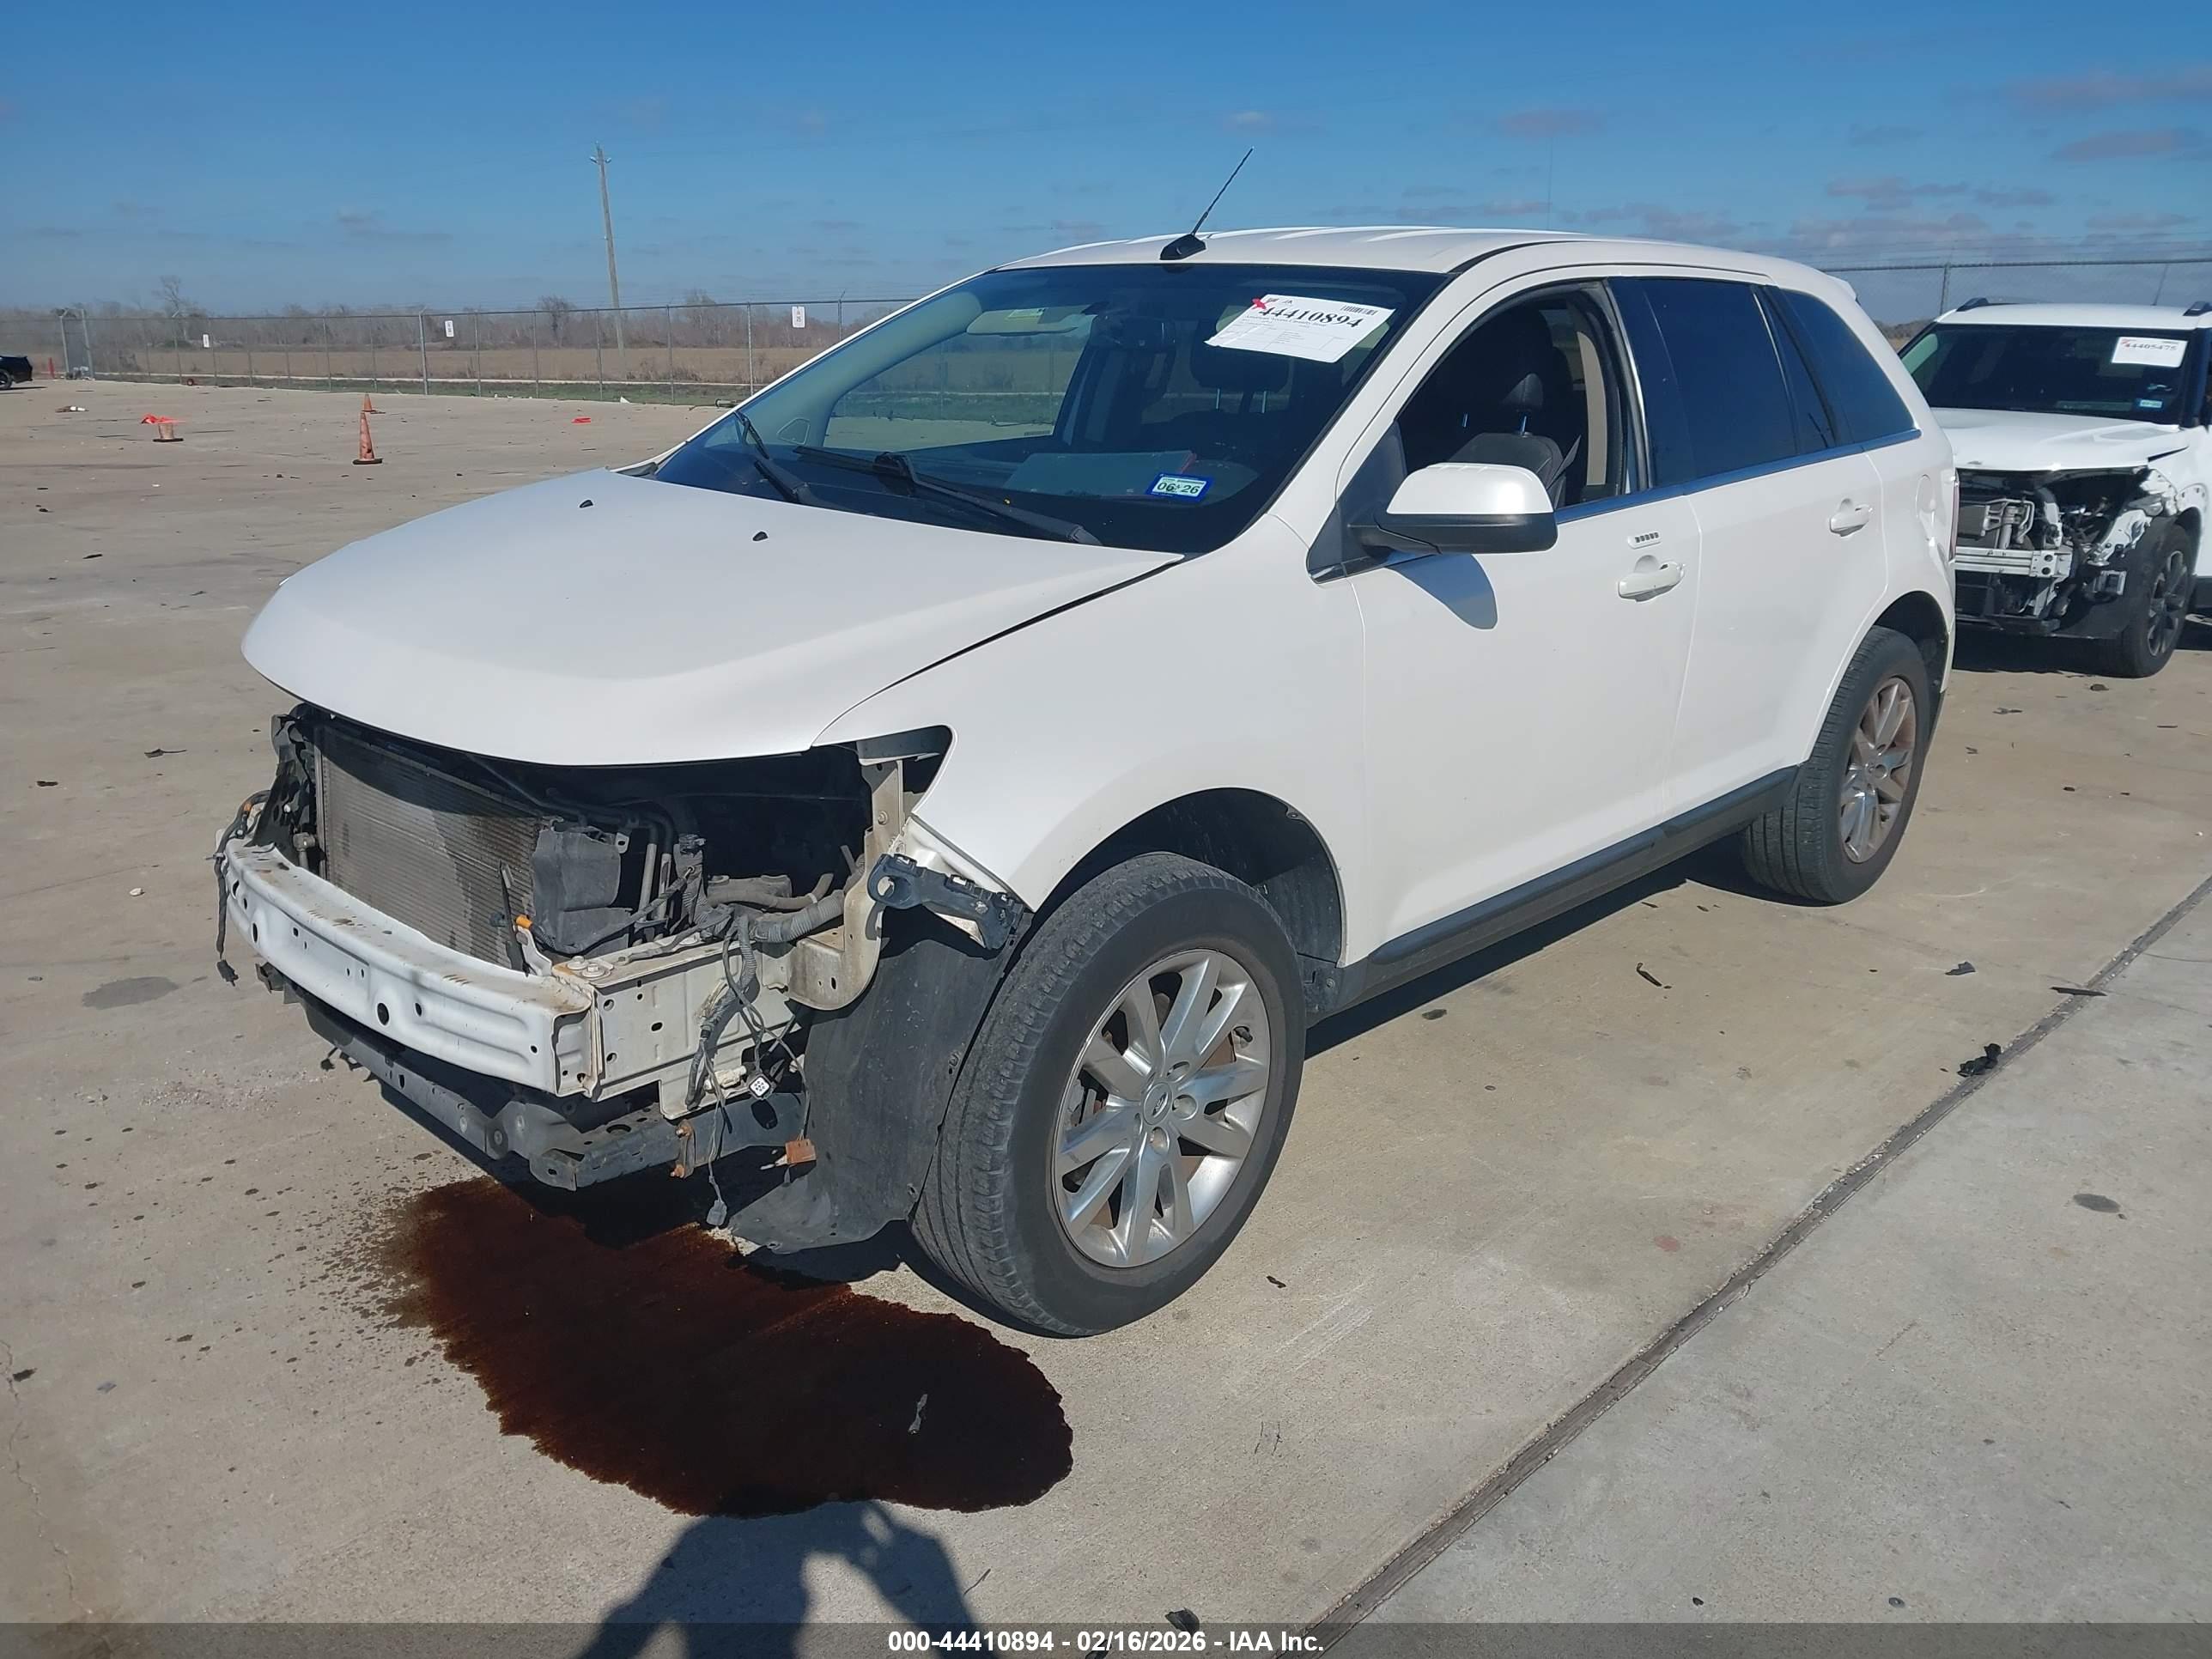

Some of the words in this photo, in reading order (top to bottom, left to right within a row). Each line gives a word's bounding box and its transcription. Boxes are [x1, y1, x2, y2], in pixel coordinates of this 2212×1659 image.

[1258, 307, 1364, 328] 44410894
[1157, 482, 1176, 492] 06
[1181, 484, 1200, 494] 26
